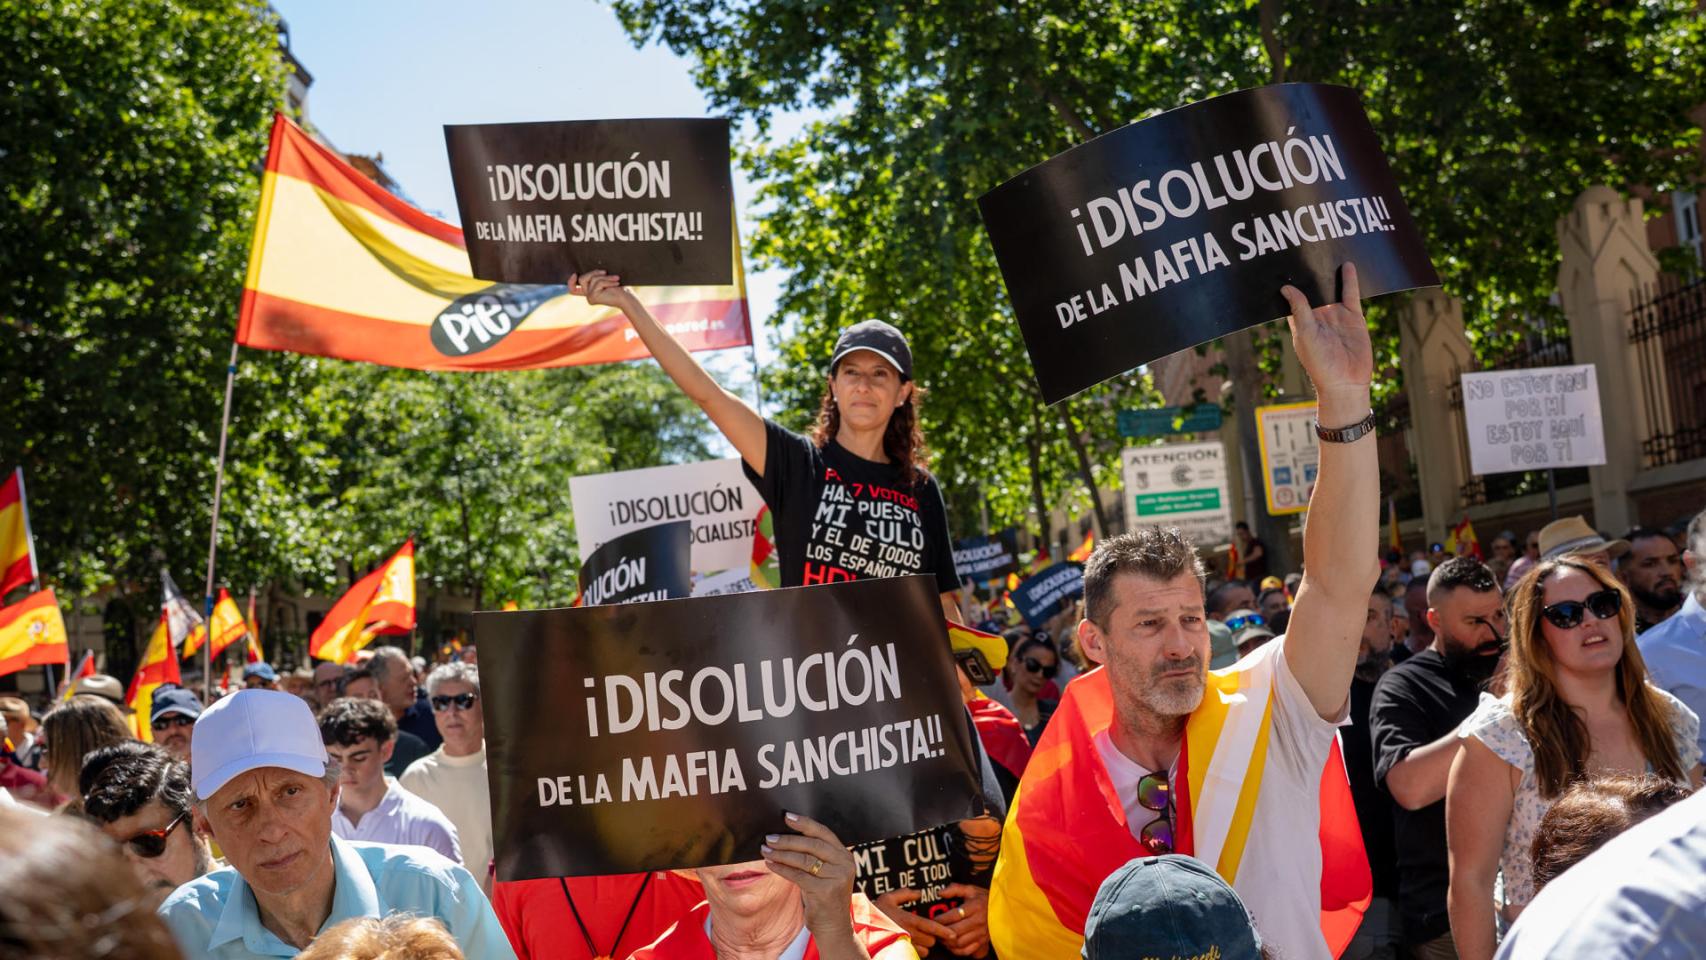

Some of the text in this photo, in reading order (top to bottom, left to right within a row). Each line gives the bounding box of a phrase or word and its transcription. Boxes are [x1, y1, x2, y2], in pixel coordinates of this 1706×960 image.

[487, 152, 671, 202] ¡DISOLUCIÓN
[1070, 126, 1347, 257] ¡DISOLUCIÓN
[475, 211, 703, 242] DE LA MAFIA SANCHISTA!!
[1055, 196, 1396, 329] DE LA MAFIA SANCHISTA!!
[1467, 380, 1495, 400] NO
[1501, 373, 1552, 397] ESTOY
[1505, 398, 1542, 419] POR
[1486, 420, 1543, 445] ESTOY
[1511, 443, 1548, 464] POR
[609, 483, 743, 527] ¡DISOLUCIÓN
[851, 483, 919, 511] 7 VOTOS
[814, 501, 925, 551] MI CULO
[806, 542, 834, 563] LOS
[811, 523, 922, 570] Y EL DE TODOS
[802, 561, 858, 586] HD
[583, 634, 903, 738] ¡DISOLUCIÓN
[537, 713, 946, 808] DE LA MAFIA SANCHISTA!!
[853, 845, 891, 878] MI
[857, 880, 868, 896] Y
[874, 875, 896, 895] EL
[898, 868, 917, 889] DE
